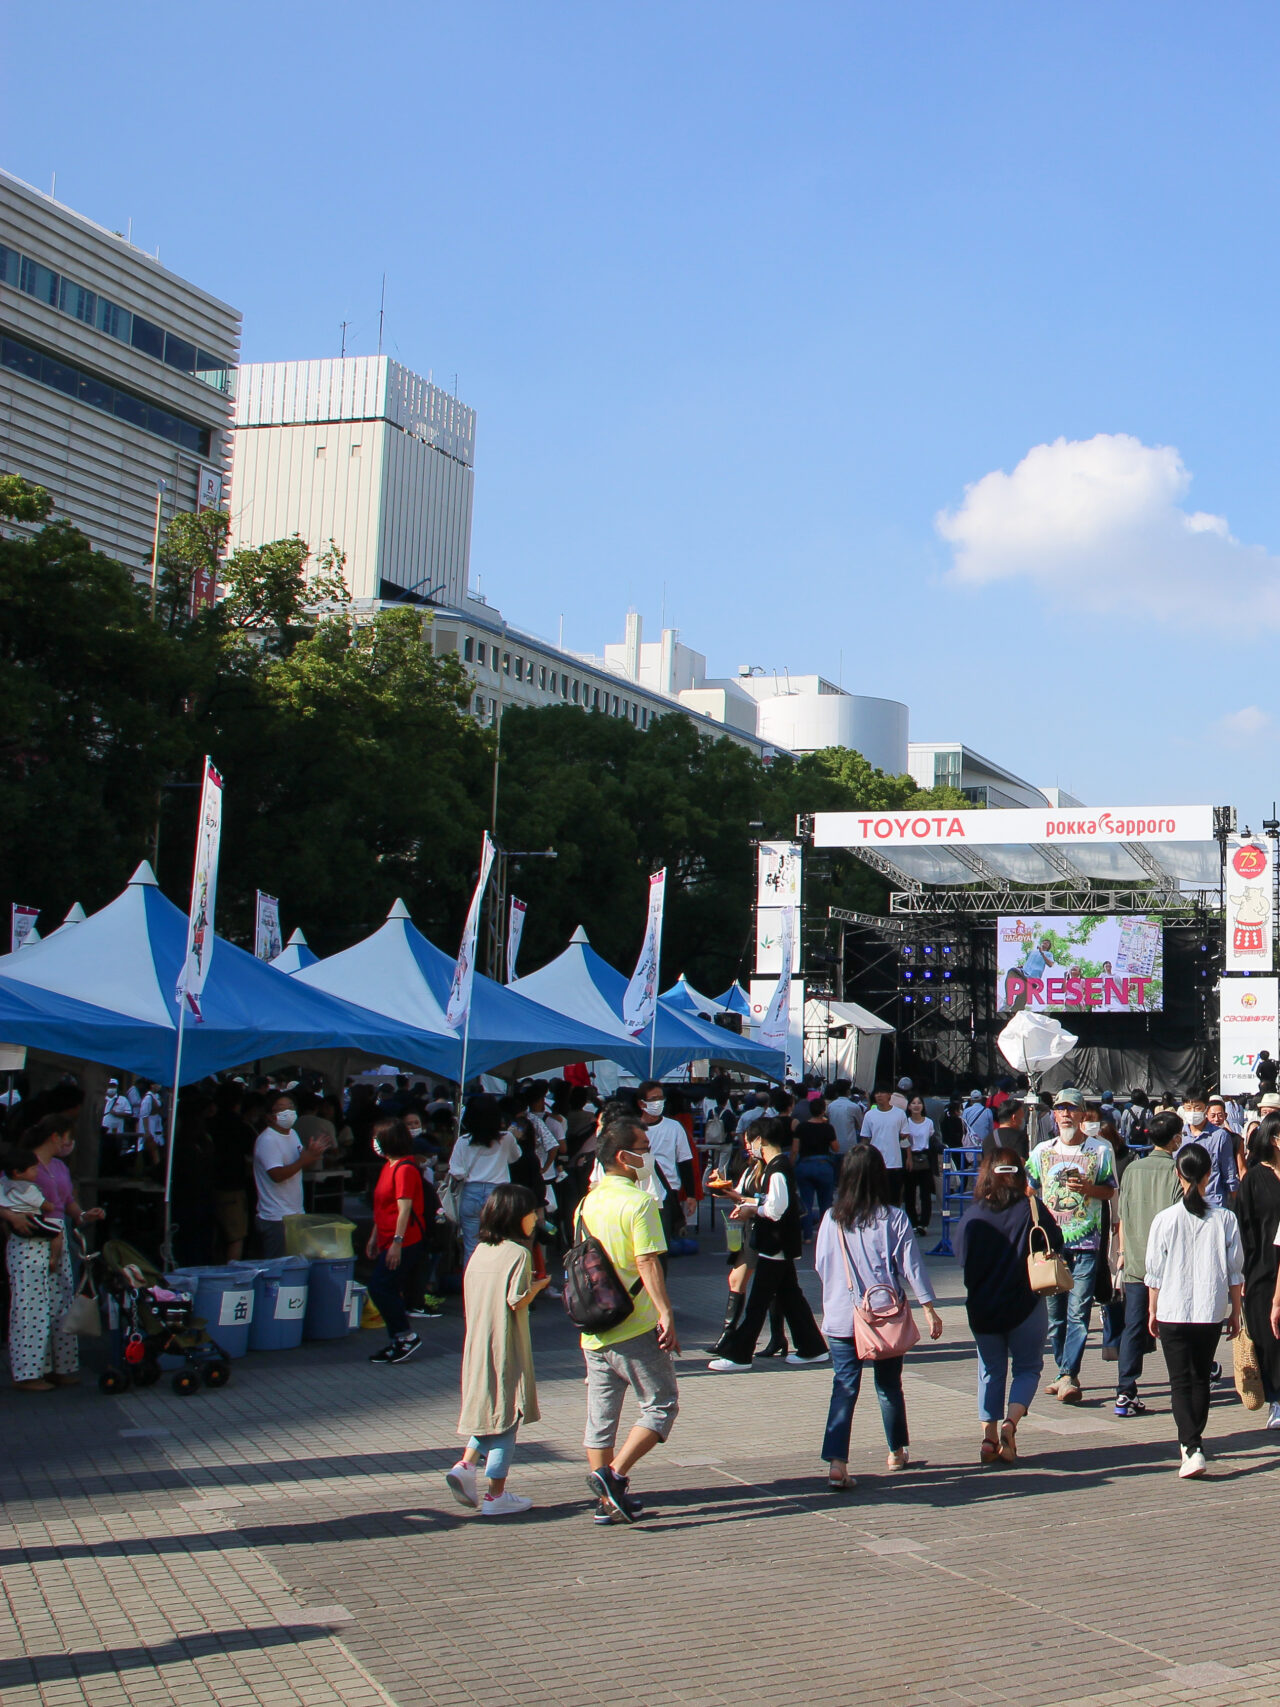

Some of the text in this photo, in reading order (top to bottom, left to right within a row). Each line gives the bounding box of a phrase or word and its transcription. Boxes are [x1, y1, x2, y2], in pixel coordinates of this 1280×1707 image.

[858, 817, 966, 839] TOYOTA
[1240, 852, 1258, 868] 75
[1003, 934, 1033, 943] NAGOYA
[1007, 977, 1152, 1005] PRESENT
[234, 1301, 247, 1320] 缶
[288, 1298, 304, 1309] ビン
